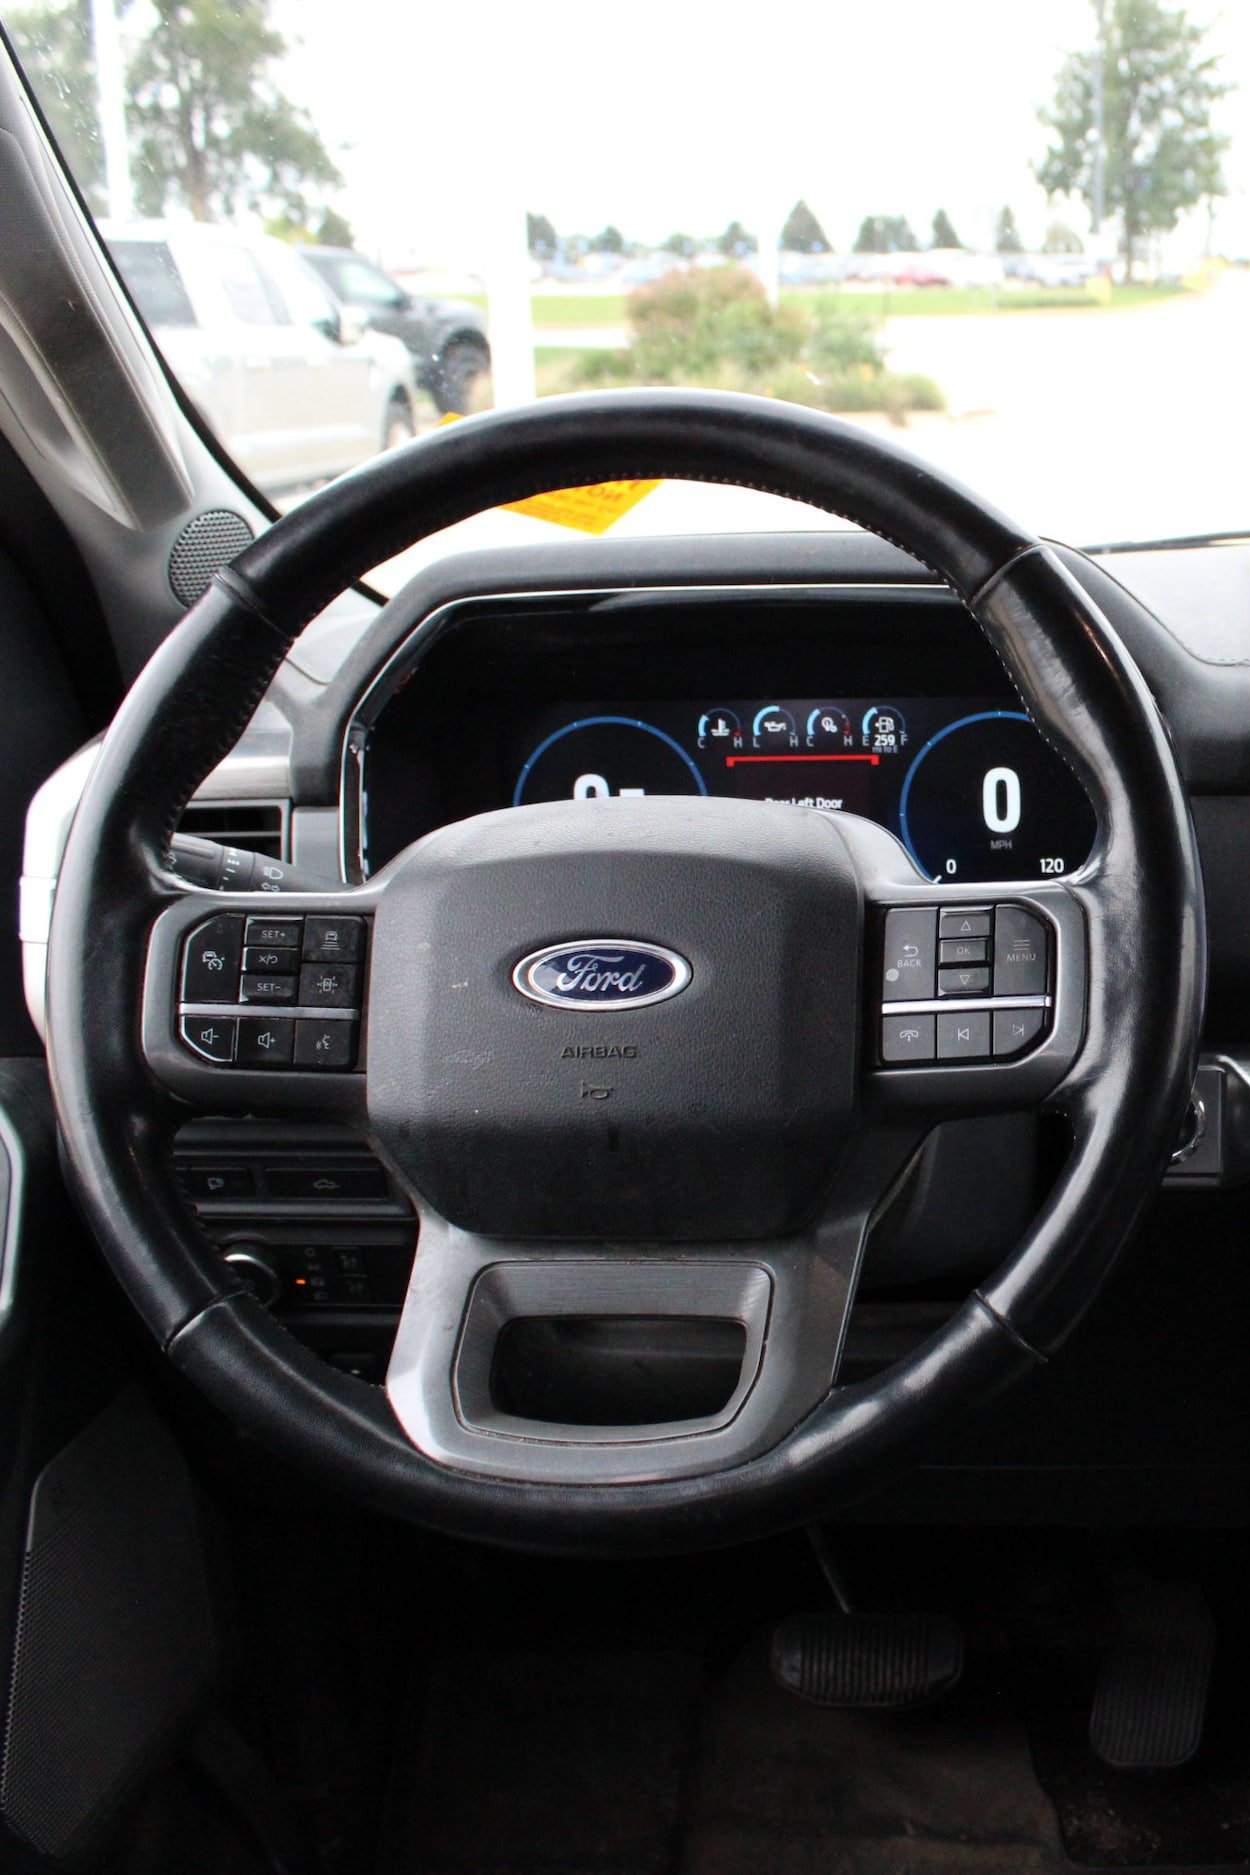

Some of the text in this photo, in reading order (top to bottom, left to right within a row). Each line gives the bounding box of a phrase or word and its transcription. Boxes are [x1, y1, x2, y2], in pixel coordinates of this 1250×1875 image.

[697, 737, 706, 749] C
[733, 737, 743, 748] H
[753, 737, 760, 748] L
[789, 736, 799, 747] H
[806, 736, 815, 747] C
[844, 736, 853, 747] H
[862, 736, 870, 746] E
[874, 734, 895, 747] 259
[901, 735, 909, 746] F
[816, 796, 843, 809] Door
[982, 766, 1021, 833] 0
[990, 839, 1013, 850] MPH
[945, 858, 957, 875] 0
[1040, 857, 1065, 874] 120
[956, 946, 970, 956] OK
[897, 958, 922, 968] BACK
[1006, 953, 1037, 963] MENU
[556, 953, 648, 993] Ford
[561, 1045, 637, 1059] AIRBAG
